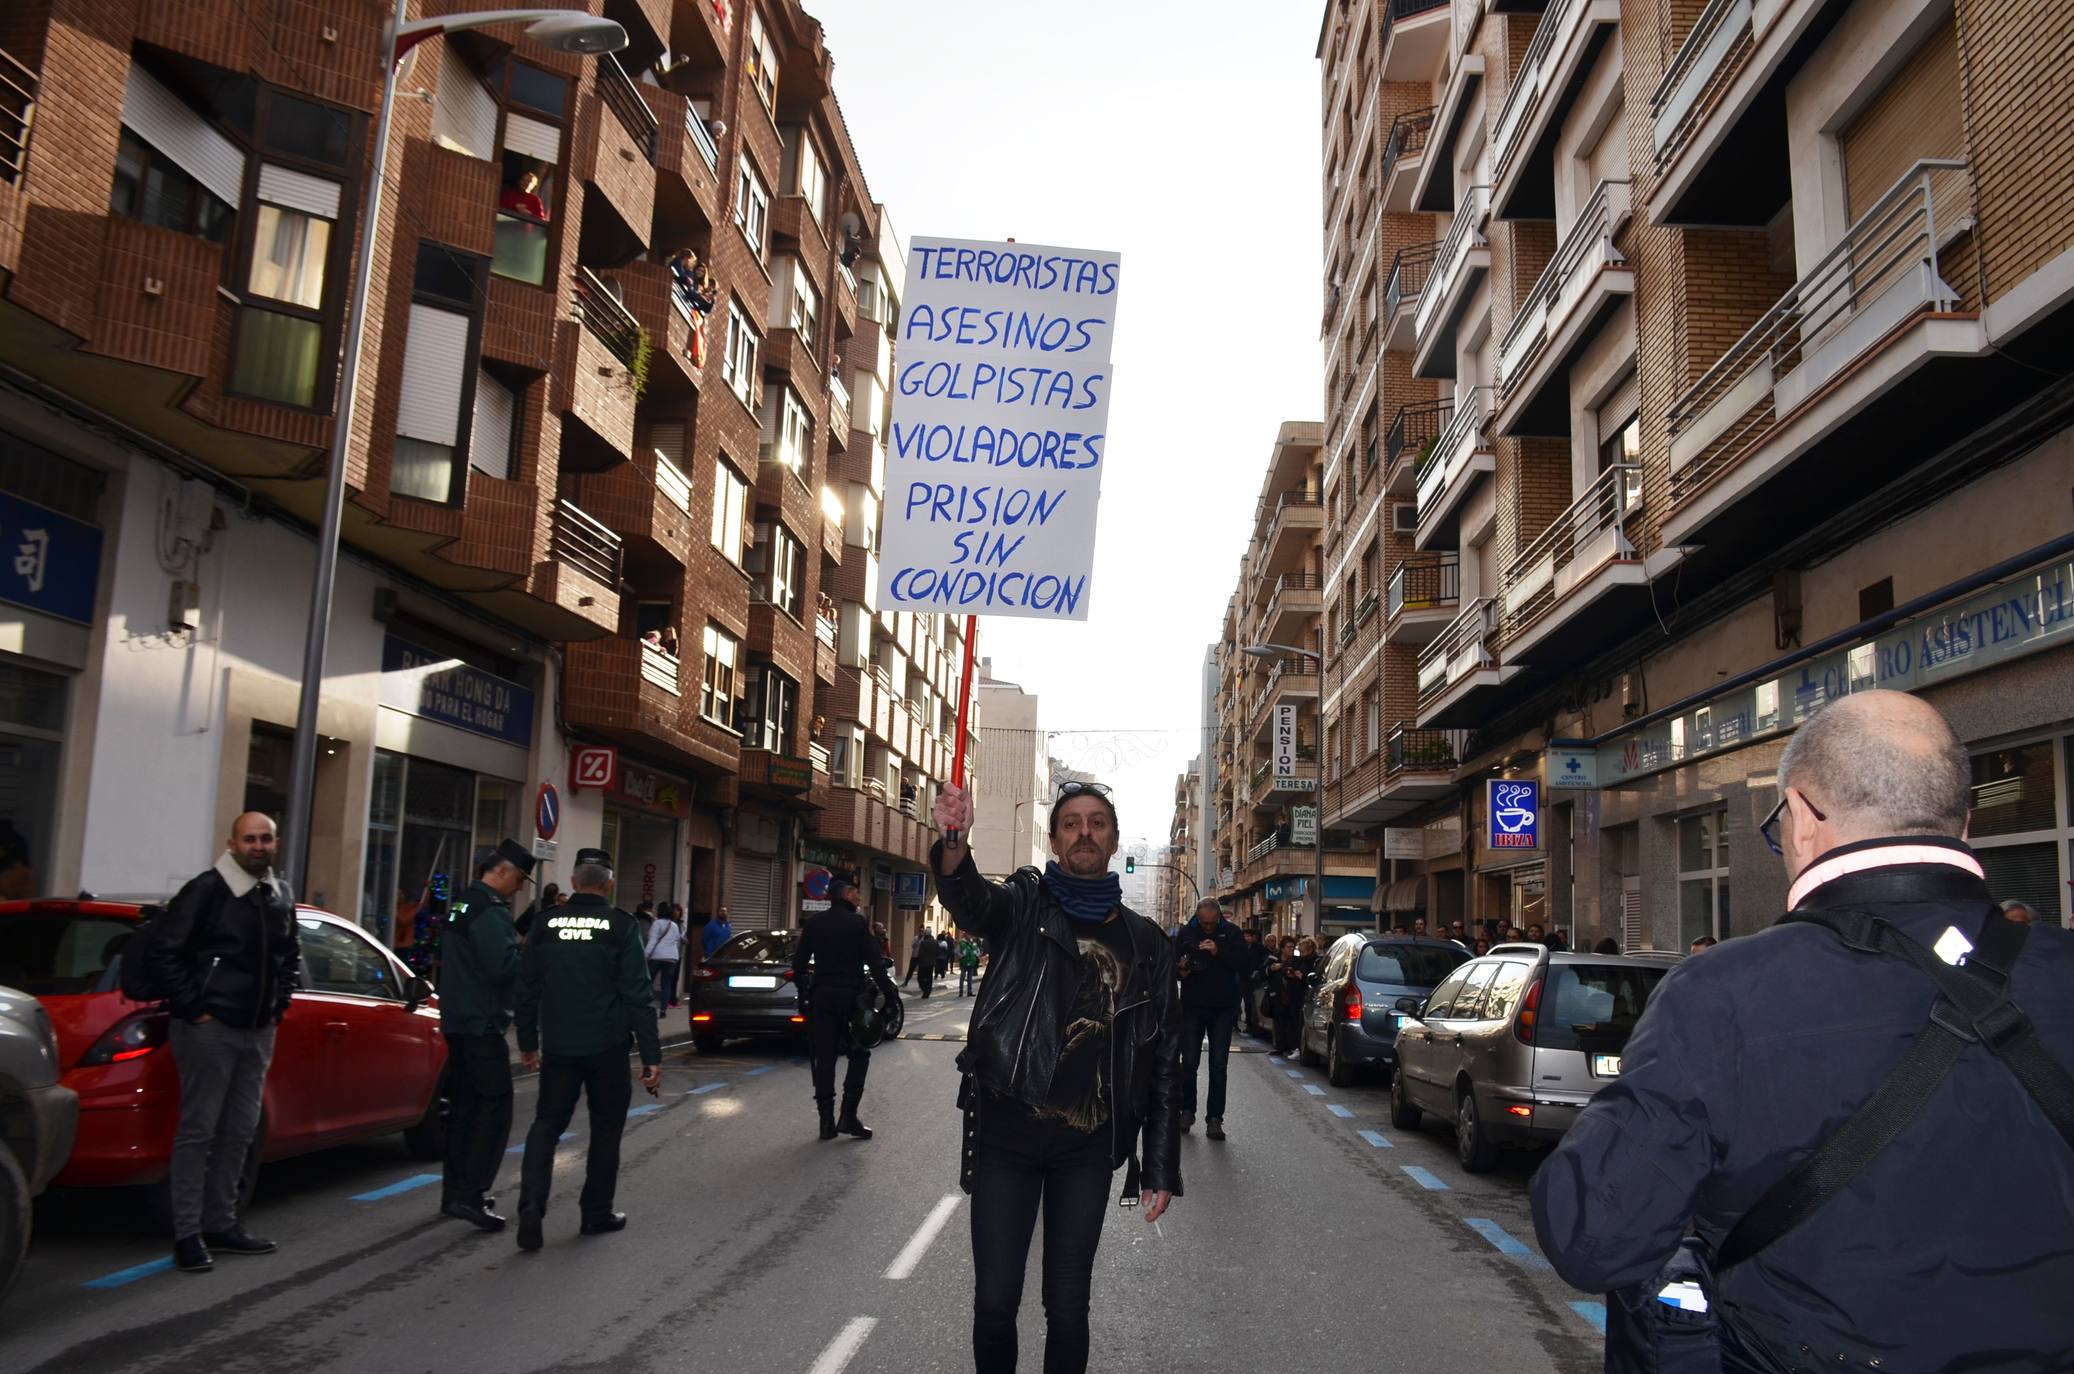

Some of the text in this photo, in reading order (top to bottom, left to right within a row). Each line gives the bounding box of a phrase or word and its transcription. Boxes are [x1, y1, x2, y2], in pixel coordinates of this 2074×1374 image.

[911, 246, 1119, 295] TERRORISTAS
[906, 304, 1107, 353] ASESINOS
[899, 360, 1105, 410] GOLPISTAS
[893, 422, 1105, 470] VIOLADORES
[905, 481, 1067, 527] PRISION
[949, 530, 1026, 568] SIN
[890, 567, 1086, 615] CONDICION
[455, 669, 493, 708] HONG
[495, 686, 511, 714] DA
[1823, 640, 1912, 700] CENTRO
[434, 692, 459, 718] PARA
[461, 702, 473, 723] EL
[475, 706, 505, 732] HOGAR
[1279, 706, 1292, 775] PENSION
[1275, 780, 1314, 789] TERESA
[1297, 819, 1314, 828] PIEL
[1495, 833, 1534, 847] IBIZA
[547, 916, 610, 931] GUARDIA
[558, 928, 593, 941] CIVIL
